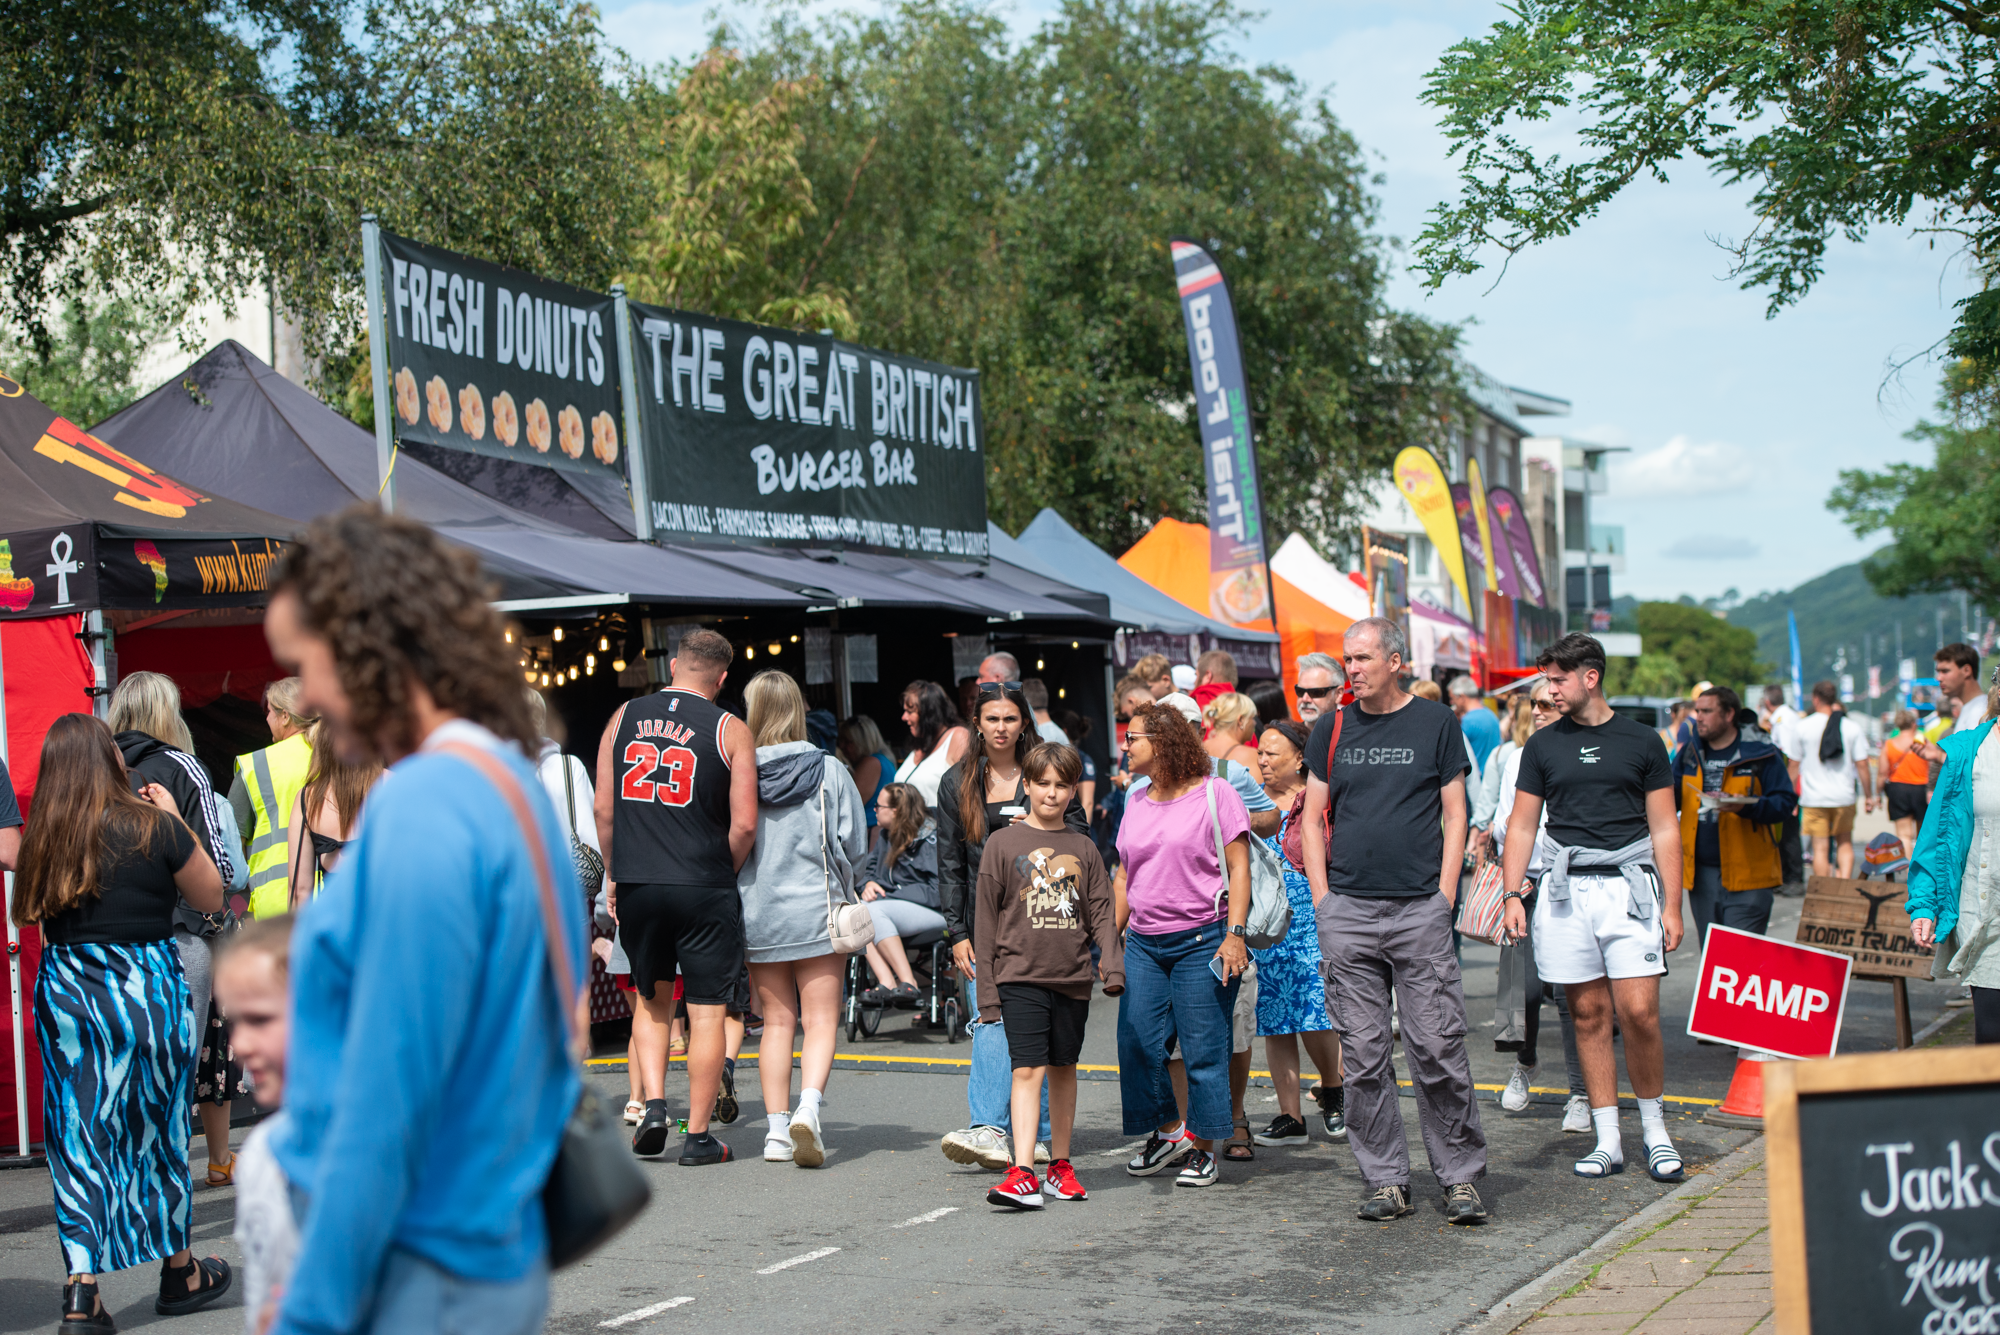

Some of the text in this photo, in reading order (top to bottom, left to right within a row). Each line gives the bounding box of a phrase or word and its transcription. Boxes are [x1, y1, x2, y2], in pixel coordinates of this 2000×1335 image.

[392, 257, 605, 386] FRESH DONUTS
[643, 317, 977, 452] THE GREAT BRITISH
[750, 439, 918, 495] BURGER BAR
[652, 501, 685, 531] BACON
[682, 504, 712, 533] ROLLS
[716, 507, 770, 538] FARMHOUSE
[768, 512, 811, 539] SAUSAGE
[902, 525, 918, 549] TEA
[920, 527, 945, 553] COFFEE
[946, 530, 964, 554] COLD
[636, 719, 695, 746] JORDAN
[1368, 748, 1415, 765] SEED
[621, 740, 697, 807] 23
[1031, 917, 1077, 930] ソニック
[1805, 925, 1855, 947] TOM'S
[1886, 957, 1914, 968] WEAR
[1708, 965, 1830, 1022] RAMP
